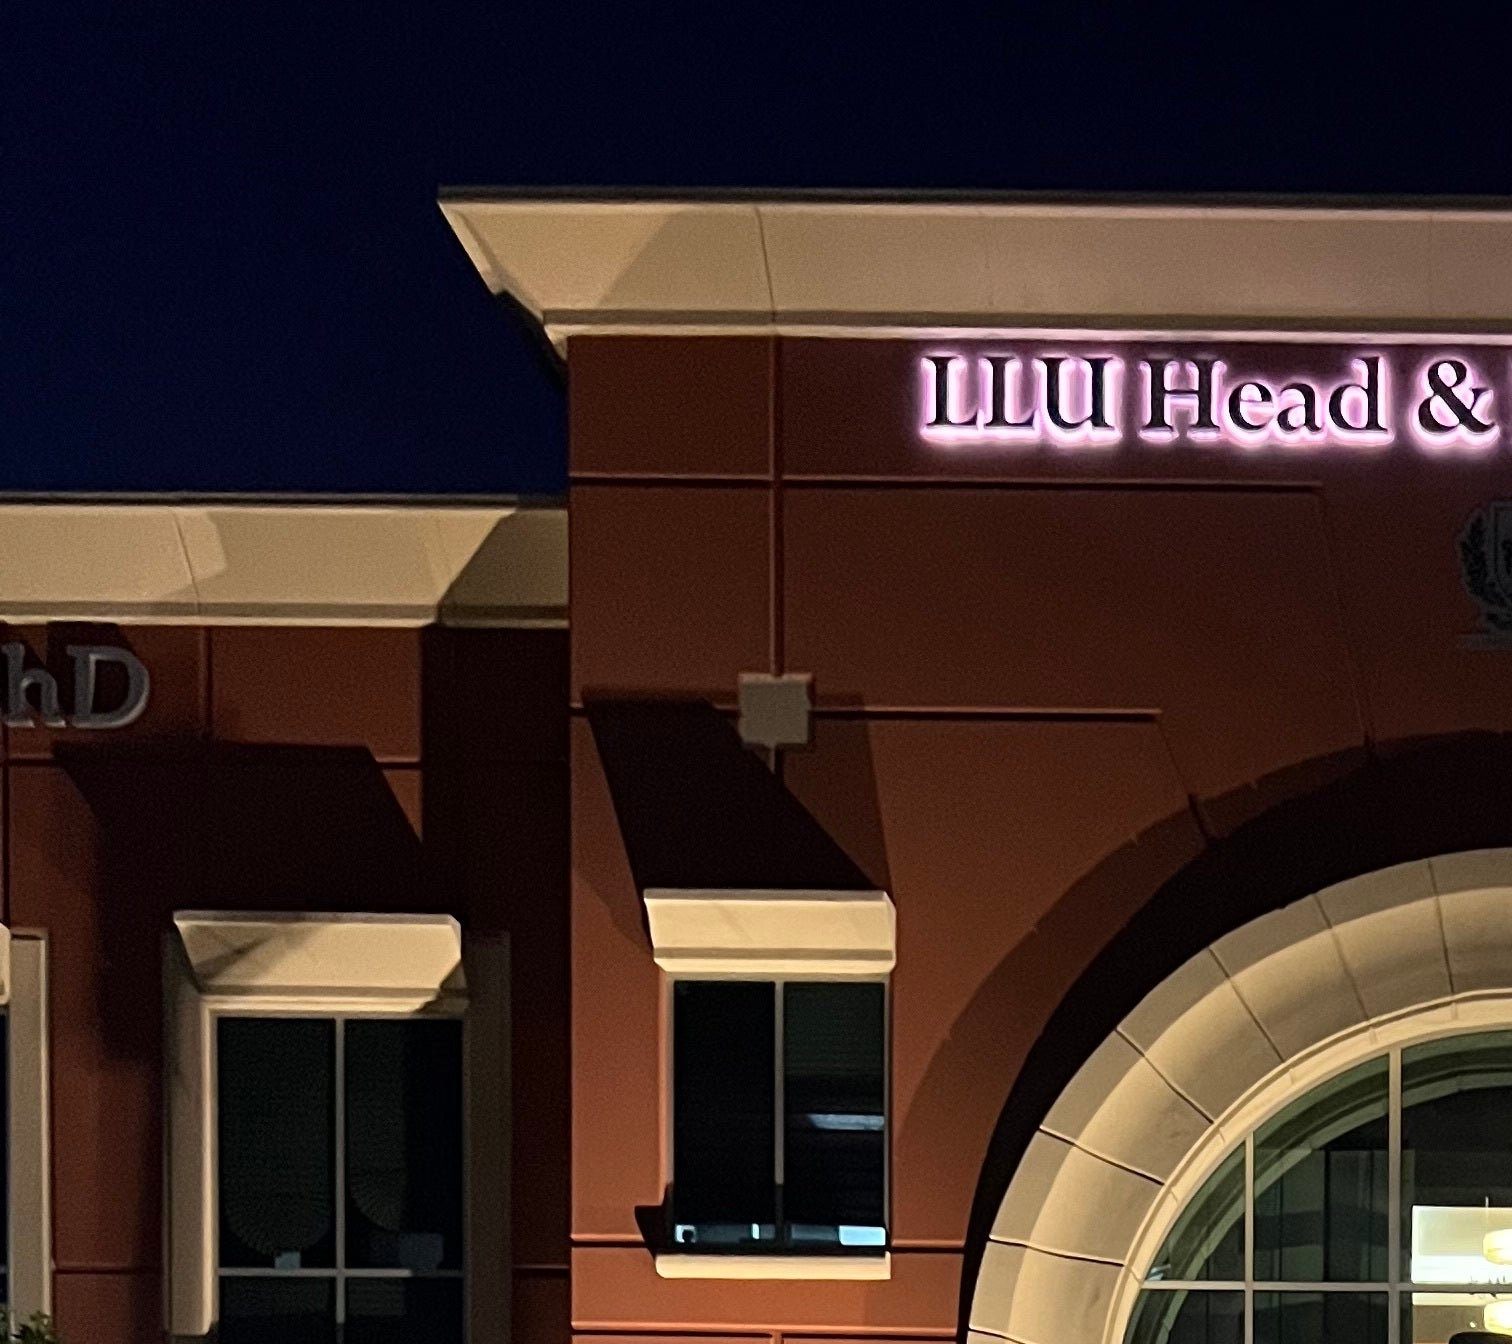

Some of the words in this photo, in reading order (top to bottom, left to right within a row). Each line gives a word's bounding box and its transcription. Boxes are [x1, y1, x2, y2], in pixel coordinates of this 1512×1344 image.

[921, 355, 1118, 434] LLU
[1143, 355, 1391, 435] Head
[1417, 358, 1498, 435] &
